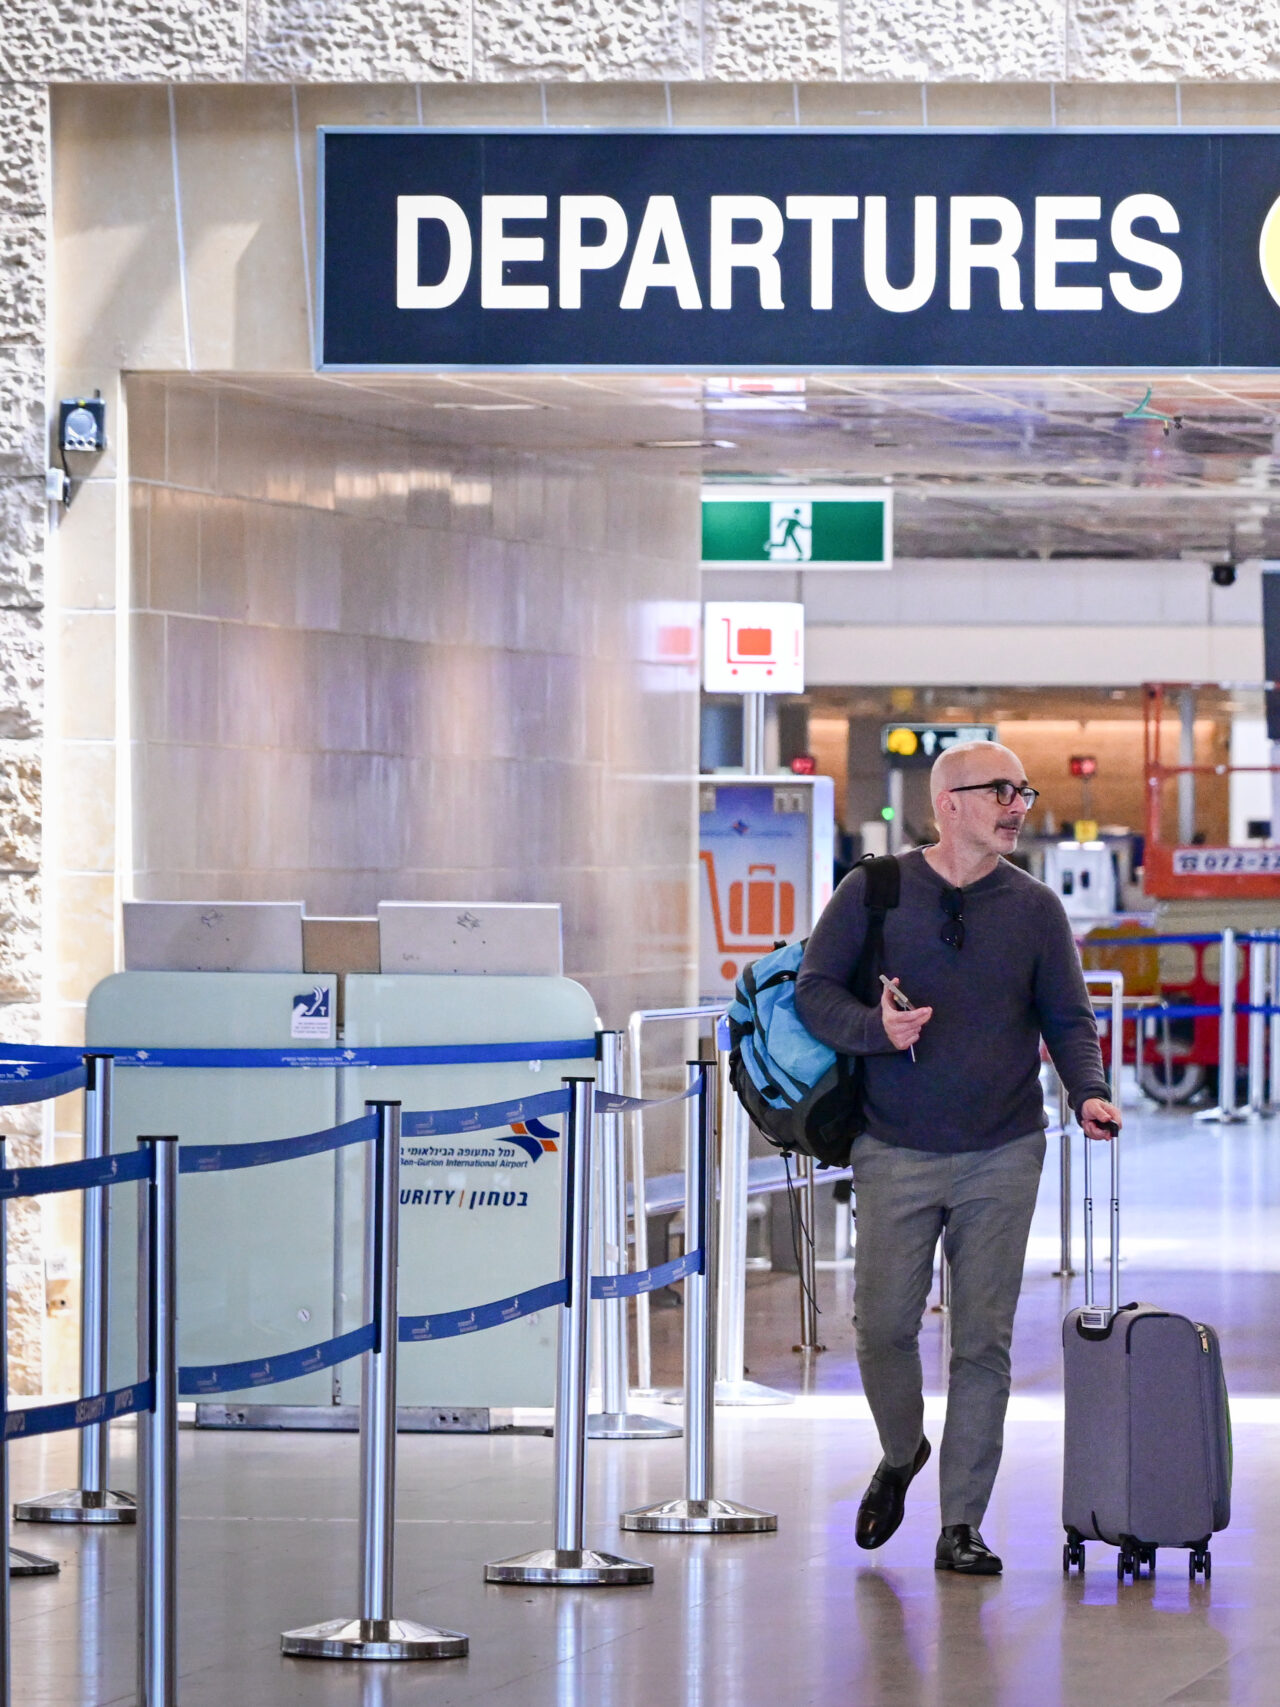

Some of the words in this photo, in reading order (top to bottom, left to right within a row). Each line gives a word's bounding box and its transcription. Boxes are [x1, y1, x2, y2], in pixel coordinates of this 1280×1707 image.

[396, 193, 1182, 313] DEPARTURES
[457, 1147, 496, 1157] התעופה
[445, 1159, 498, 1168] International
[499, 1160, 528, 1169] Airport
[400, 1190, 456, 1206] URITY
[468, 1190, 528, 1210] בטחון
